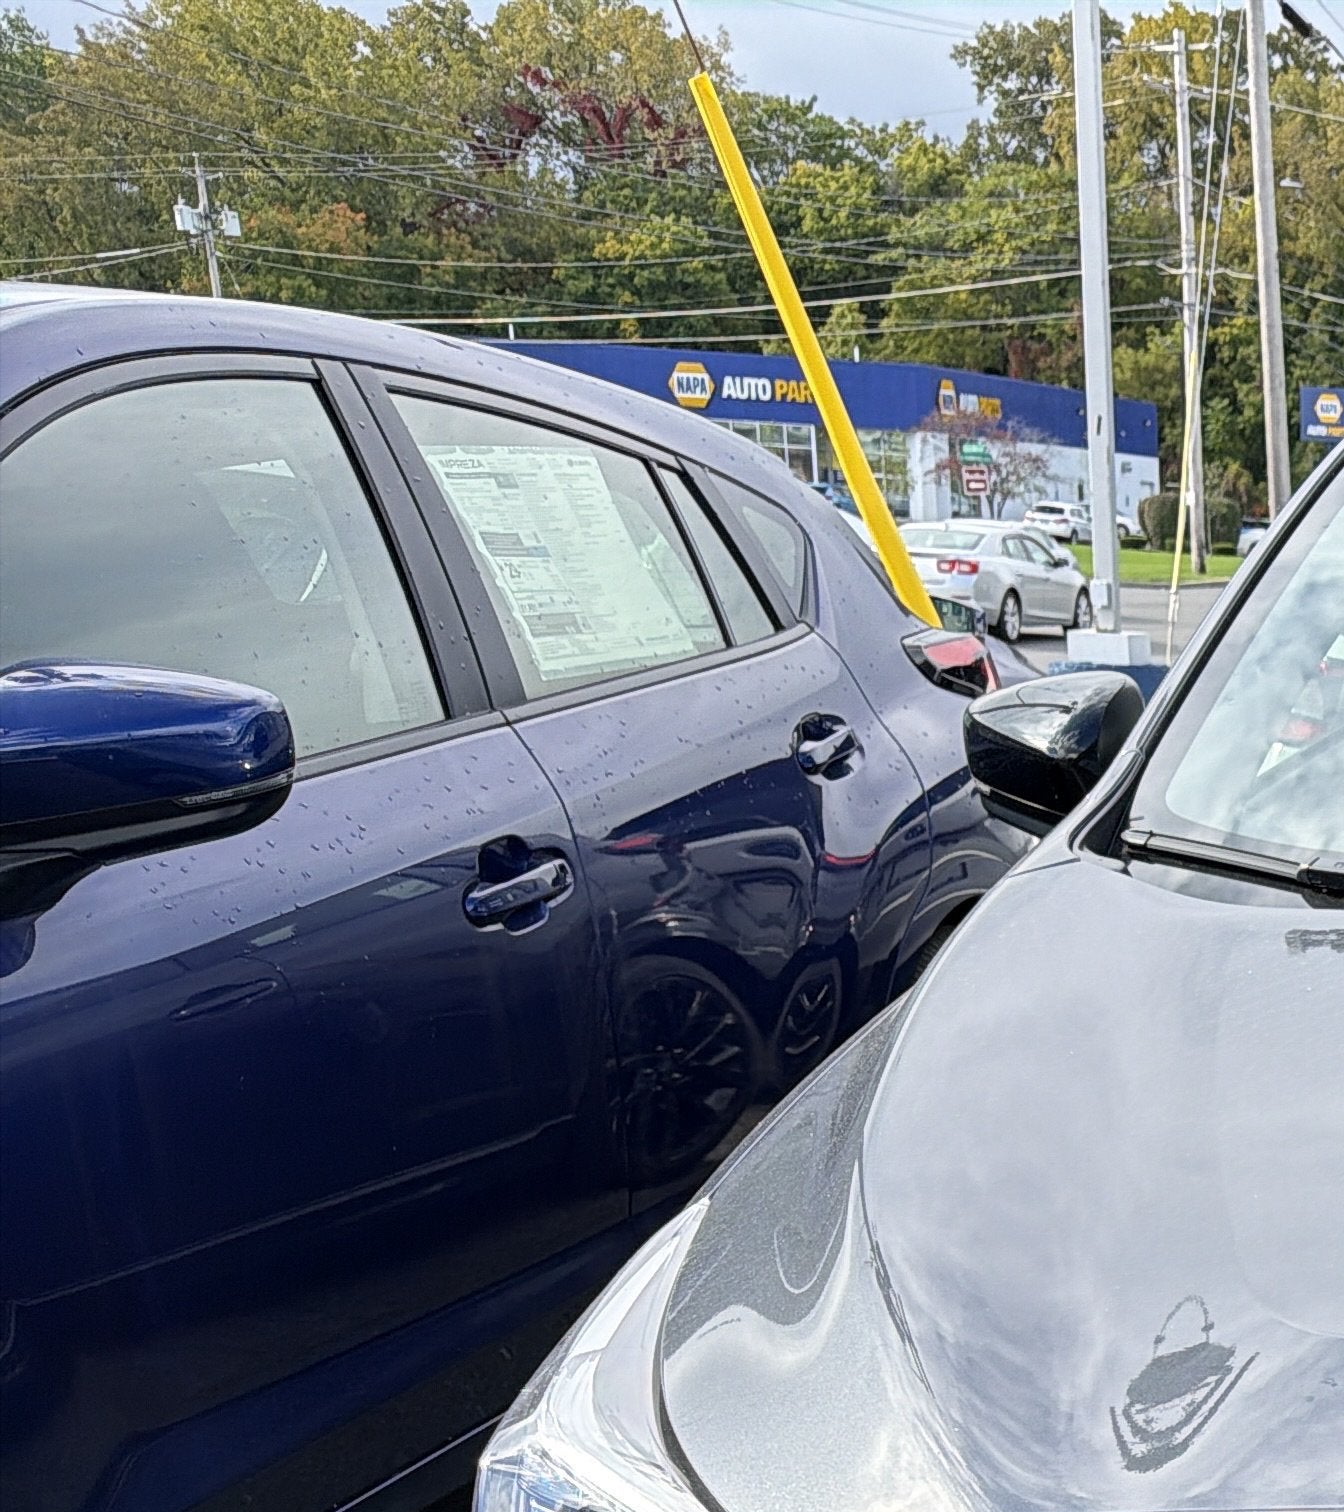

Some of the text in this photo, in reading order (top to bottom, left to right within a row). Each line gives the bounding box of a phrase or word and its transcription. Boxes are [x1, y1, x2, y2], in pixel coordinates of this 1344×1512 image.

[676, 375, 707, 396] NAPA
[721, 375, 815, 403] AUTO PAR
